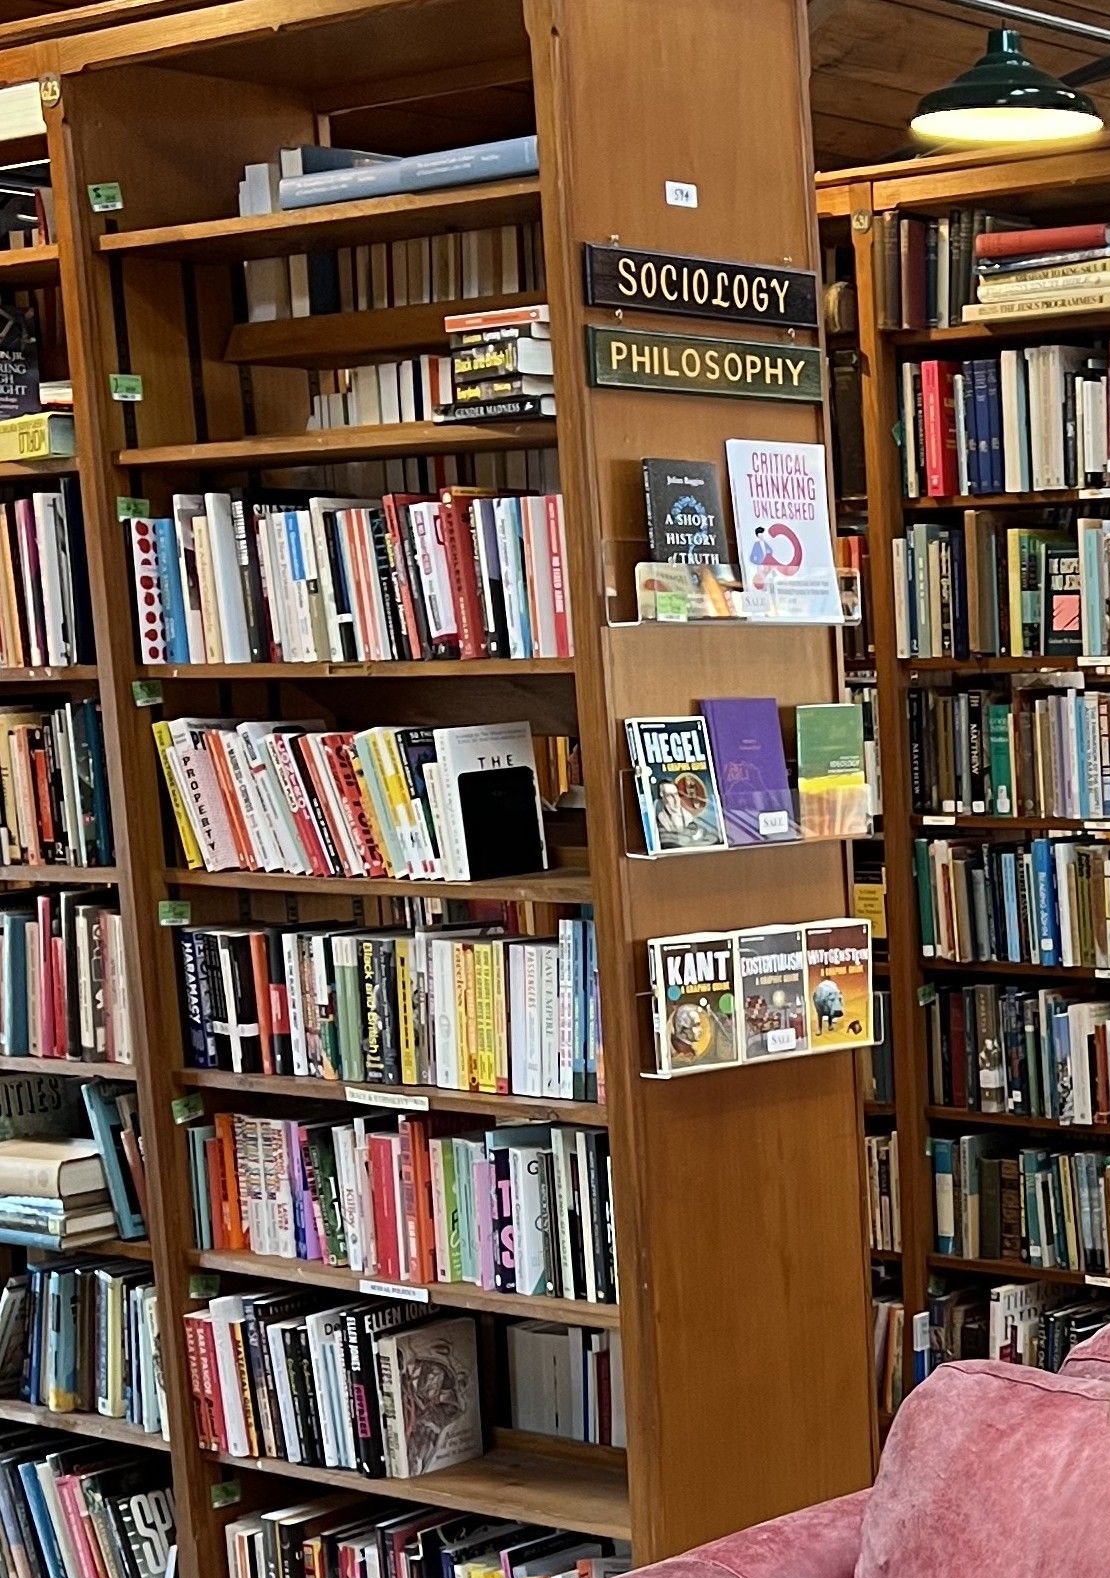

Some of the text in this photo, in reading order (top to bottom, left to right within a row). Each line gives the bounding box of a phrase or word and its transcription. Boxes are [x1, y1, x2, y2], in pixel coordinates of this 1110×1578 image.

[617, 257, 790, 314] SOCIOLOGY
[610, 340, 806, 387] PHILOSOPHY
[751, 452, 809, 476] CRITICAL
[747, 474, 816, 500] THINKING
[665, 514, 715, 527] A SHORT
[753, 501, 815, 521] UNLEASHED
[665, 533, 717, 546] HISTORY
[681, 553, 720, 565] TRUTH
[477, 754, 514, 769] THE
[643, 730, 706, 763] HEGEL
[970, 723, 979, 776] MATTHEW
[912, 742, 921, 796] MATTHEW
[182, 756, 216, 851] PROPERTY
[363, 942, 374, 981] Black
[666, 950, 731, 985] KANT
[182, 942, 202, 1025] HARAMACY
[368, 1013, 380, 1053] British
[771, 1034, 791, 1045] SALE
[365, 1306, 401, 1334] ELLEN
[196, 1328, 213, 1394] SARA PASCOE
[346, 1316, 360, 1372] ELLEN JONES
